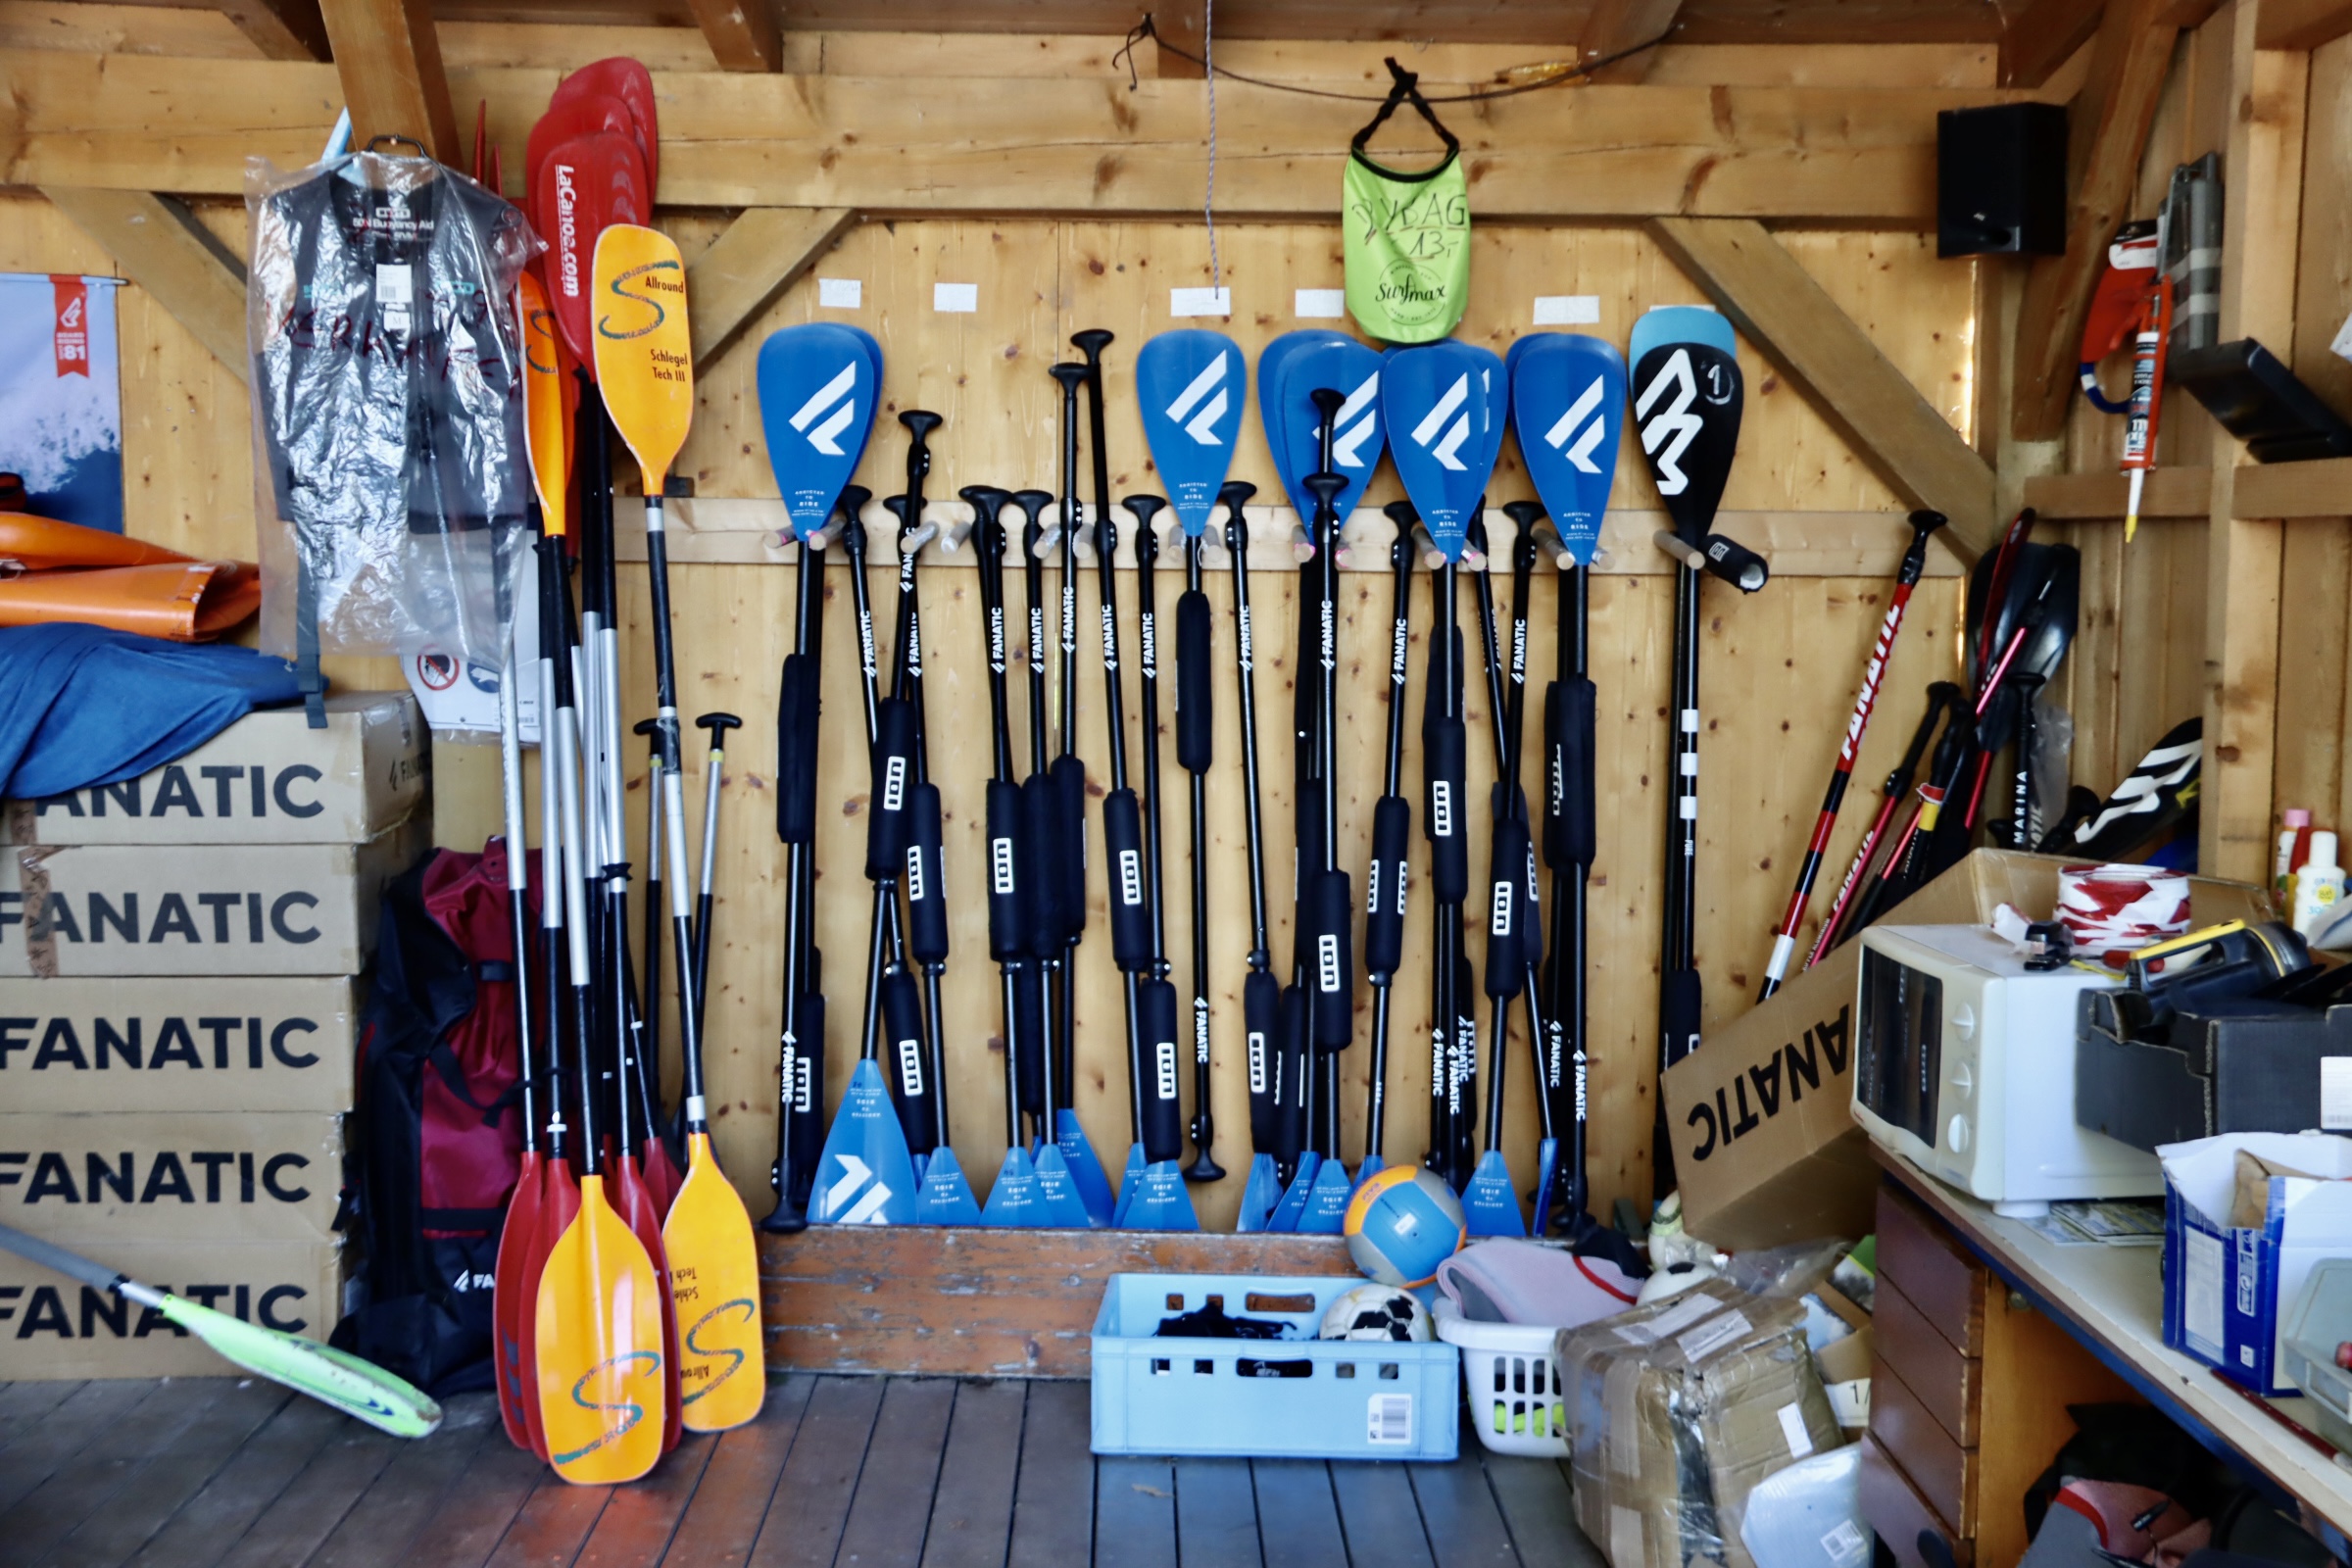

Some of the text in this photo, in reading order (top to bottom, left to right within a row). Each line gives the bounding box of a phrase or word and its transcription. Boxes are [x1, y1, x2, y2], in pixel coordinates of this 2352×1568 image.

[418, 220, 435, 229] Aid
[645, 276, 684, 292] Allround
[651, 349, 688, 367] Schlegel
[653, 367, 673, 380] Tech
[860, 611, 875, 662] FANATIC
[992, 607, 1004, 659] FANATIC
[1031, 608, 1043, 659] FANATIC
[1063, 586, 1074, 639] FANATIC
[1102, 604, 1114, 657] FANATIC
[1143, 612, 1154, 664] FANATIC
[1239, 605, 1250, 657] FANATIC
[1321, 600, 1333, 655] FANATIC
[1393, 618, 1407, 670] FANATIC
[1513, 619, 1526, 670] FANATIC
[36, 764, 325, 817] ANATIC
[2013, 770, 2029, 844] MARINA
[1685, 839, 1693, 857] PURE
[0, 1017, 319, 1070] FANATIC
[1196, 1011, 1208, 1064] FANATIC
[1458, 1030, 1469, 1083] FANATIC
[1550, 1035, 1562, 1088] FANATIC
[782, 1047, 794, 1103] FANATIC
[1433, 1043, 1445, 1098] FANATIC
[1449, 1060, 1460, 1115] FANATIC
[1576, 1065, 1586, 1121] FANATIC
[1688, 1004, 1850, 1161] ANATIC
[473, 1274, 495, 1288] FA
[674, 1286, 698, 1303] Schle
[676, 1267, 698, 1283] Tech
[680, 1364, 710, 1380] Allro
